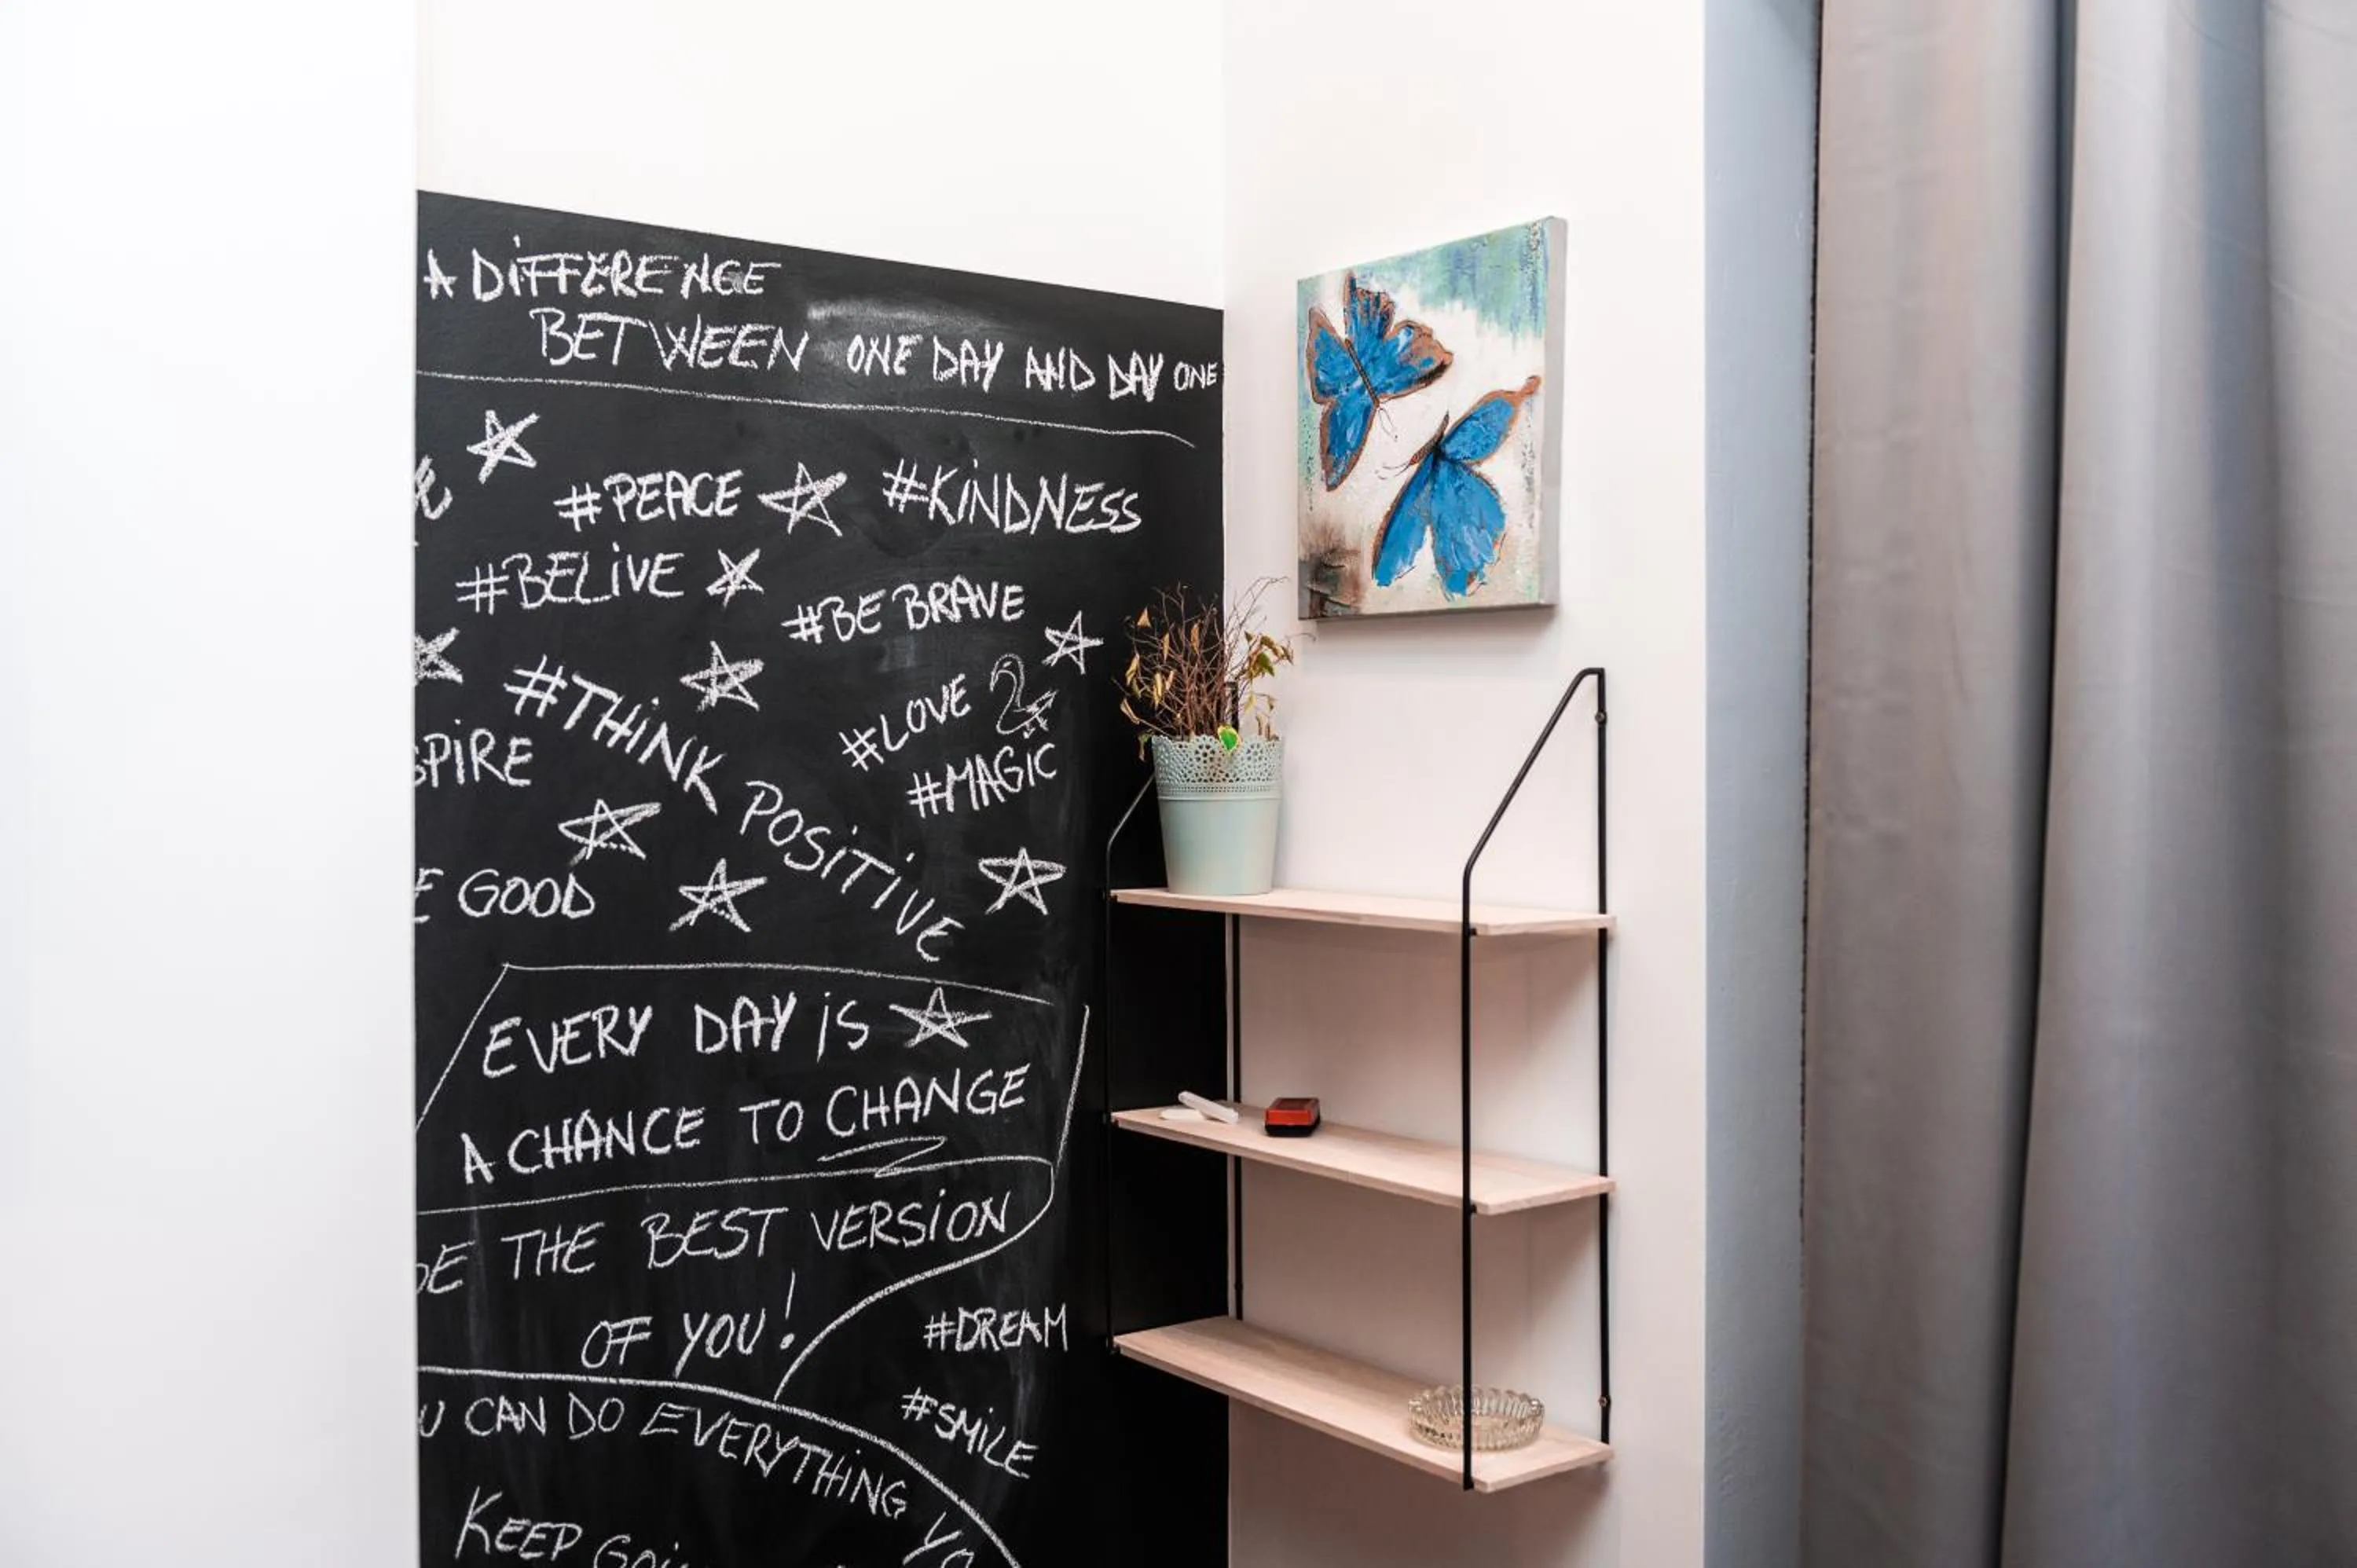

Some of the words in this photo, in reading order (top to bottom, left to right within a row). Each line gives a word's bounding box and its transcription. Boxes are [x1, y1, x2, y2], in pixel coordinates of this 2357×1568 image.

[424, 249, 457, 299] A
[530, 307, 809, 372] BETWEEN
[847, 334, 923, 376] ONE
[933, 335, 1004, 393] DAY
[1025, 346, 1097, 391] AND
[1108, 350, 1164, 403] DAY
[1173, 361, 1218, 391] ONE
[553, 470, 744, 533] #PEACE
[781, 588, 885, 644] #BE
[892, 574, 1025, 630] BRAVE
[838, 673, 972, 771] #LOVE
[906, 742, 1058, 819] #MAGIC
[457, 868, 596, 919] GOOD
[482, 1005, 654, 1079] EVERY
[694, 991, 797, 1053] DAY
[460, 1132, 495, 1185] A
[507, 1105, 706, 1174] CHANCE
[739, 1099, 805, 1145] TO
[826, 1063, 1031, 1138] CHANGE
[500, 1222, 605, 1280] THE
[640, 1207, 789, 1270] BEST
[581, 1316, 653, 1369] OF
[923, 1302, 1069, 1353] #DREAM
[464, 1394, 548, 1438] CAN
[568, 1390, 625, 1440] DO
[455, 1486, 584, 1562] KEEP
